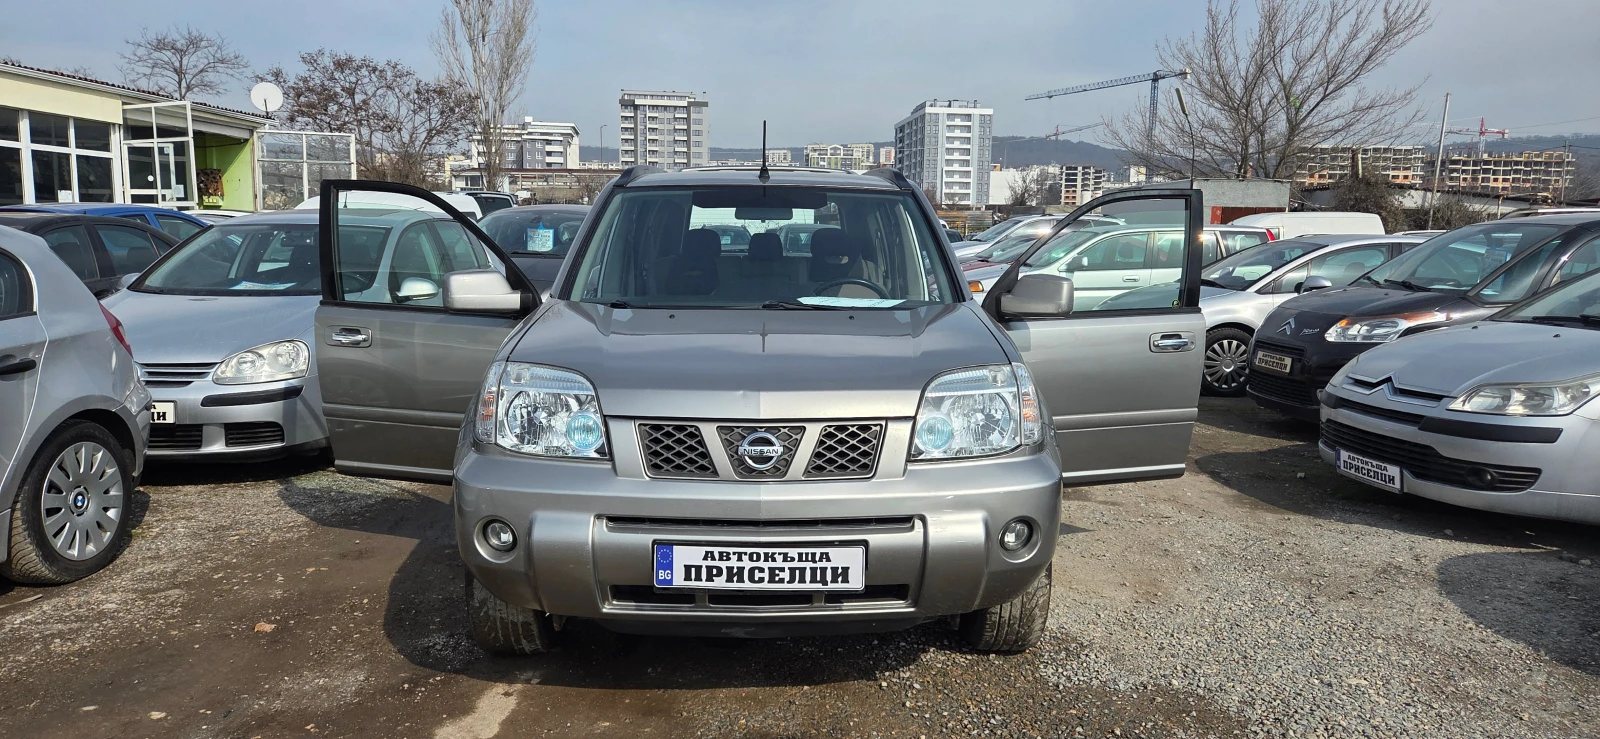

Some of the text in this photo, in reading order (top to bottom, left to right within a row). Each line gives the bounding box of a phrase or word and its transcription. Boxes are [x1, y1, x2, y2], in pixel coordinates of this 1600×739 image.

[1342, 459, 1396, 486] ПРИСЕЛЦИ
[1347, 454, 1389, 473] АВТОКЪЩА
[702, 550, 832, 564] АВТОКЪЩА
[658, 569, 672, 580] BG
[683, 564, 850, 587] ПРИСЕЛЦИ
